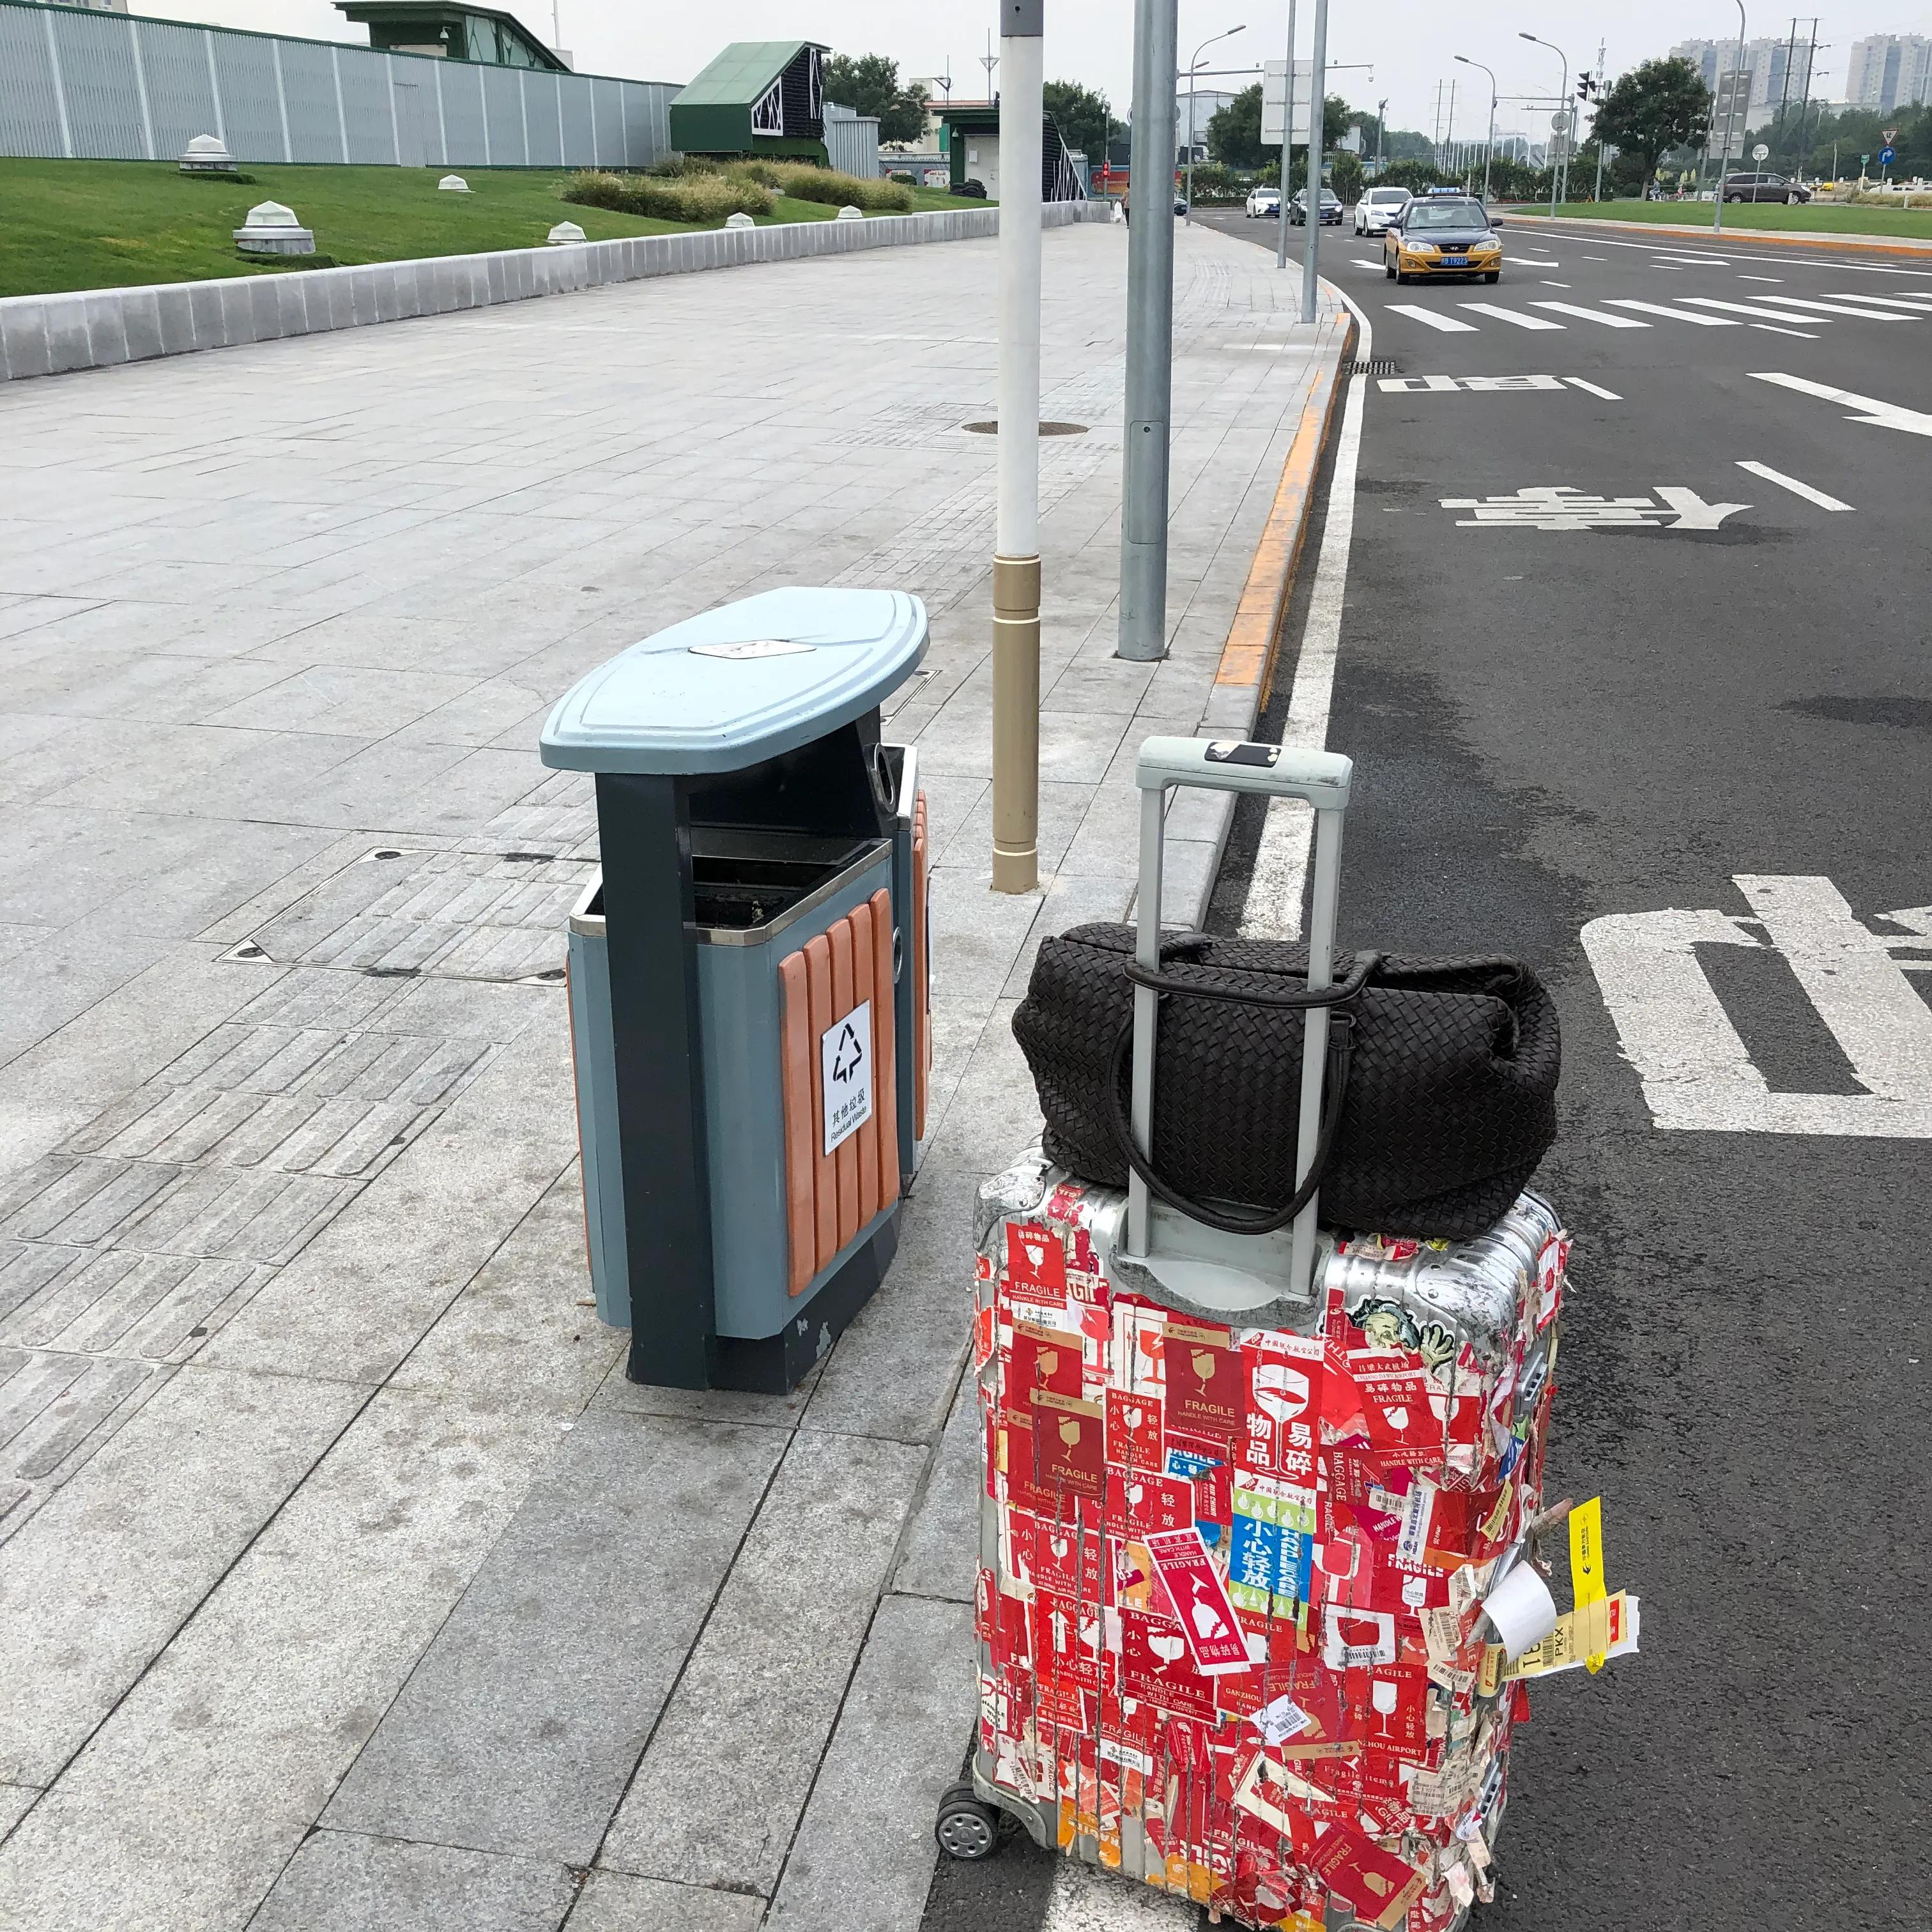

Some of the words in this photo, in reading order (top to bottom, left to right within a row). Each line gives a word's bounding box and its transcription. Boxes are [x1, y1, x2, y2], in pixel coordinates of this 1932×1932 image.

[1438, 487, 1754, 530] 停
[832, 1088, 865, 1128] 其他垃圾
[831, 1121, 852, 1142] Residual
[852, 1106, 867, 1124] Waste
[1015, 1282, 1061, 1298] FRAGILE
[1048, 1300, 1064, 1308] CARE
[1365, 1381, 1417, 1393] 易碎物品
[1111, 1392, 1153, 1407] BAGGAGE
[1373, 1395, 1413, 1404] FRAGILE
[1184, 1400, 1235, 1418] FRAGILE
[1110, 1406, 1120, 1431] 小心
[1177, 1411, 1201, 1420] HANDLE
[1202, 1414, 1216, 1423] WITH
[1218, 1418, 1236, 1427] CARE
[1147, 1414, 1158, 1441] 轻放
[1113, 1439, 1150, 1455] FRAGILE
[1246, 1413, 1271, 1467] 物品
[1285, 1422, 1312, 1475] 易碎
[1141, 1459, 1158, 1468] CARE
[1380, 1458, 1405, 1467] HANDLE
[1052, 1464, 1098, 1483] FRAGILE
[1107, 1467, 1163, 1487] BAGGAGE
[1333, 1451, 1347, 1501] BAGGAGE
[1024, 1481, 1066, 1503] FRAGILE
[1082, 1482, 1098, 1491] CARE
[1162, 1492, 1175, 1528] 轻放
[1112, 1514, 1153, 1529] FRAGILE
[1373, 1517, 1394, 1533] HANDLE
[1128, 1526, 1146, 1535] WITH
[1022, 1529, 1033, 1560] 小心
[1084, 1547, 1098, 1581] 轻放
[1162, 1558, 1207, 1571] FRAGILE
[1241, 1521, 1273, 1591] 小心轻放
[1388, 1554, 1444, 1577] FRAGILE
[1040, 1566, 1078, 1583] FRAGILE
[1055, 1579, 1072, 1588] WITH
[1126, 1630, 1141, 1657] 小心
[1555, 1627, 1563, 1656] PKX
[1199, 1643, 1241, 1659] 易碎物品
[1053, 1654, 1107, 1681] 小心轻放
[1075, 1674, 1092, 1685] WITH
[1130, 1670, 1206, 1699] FRAGILE
[1268, 1679, 1315, 1692] FRAGILE
[1140, 1682, 1175, 1698] HANDLE
[1225, 1687, 1261, 1702] GANZHOU
[1173, 1698, 1195, 1710] CARE
[1406, 1705, 1416, 1738] 小心轻放
[1386, 1744, 1422, 1756] AIRPORT
[1324, 1765, 1360, 1780] Fragile
[1321, 1843, 1353, 1876] FRAGILE
